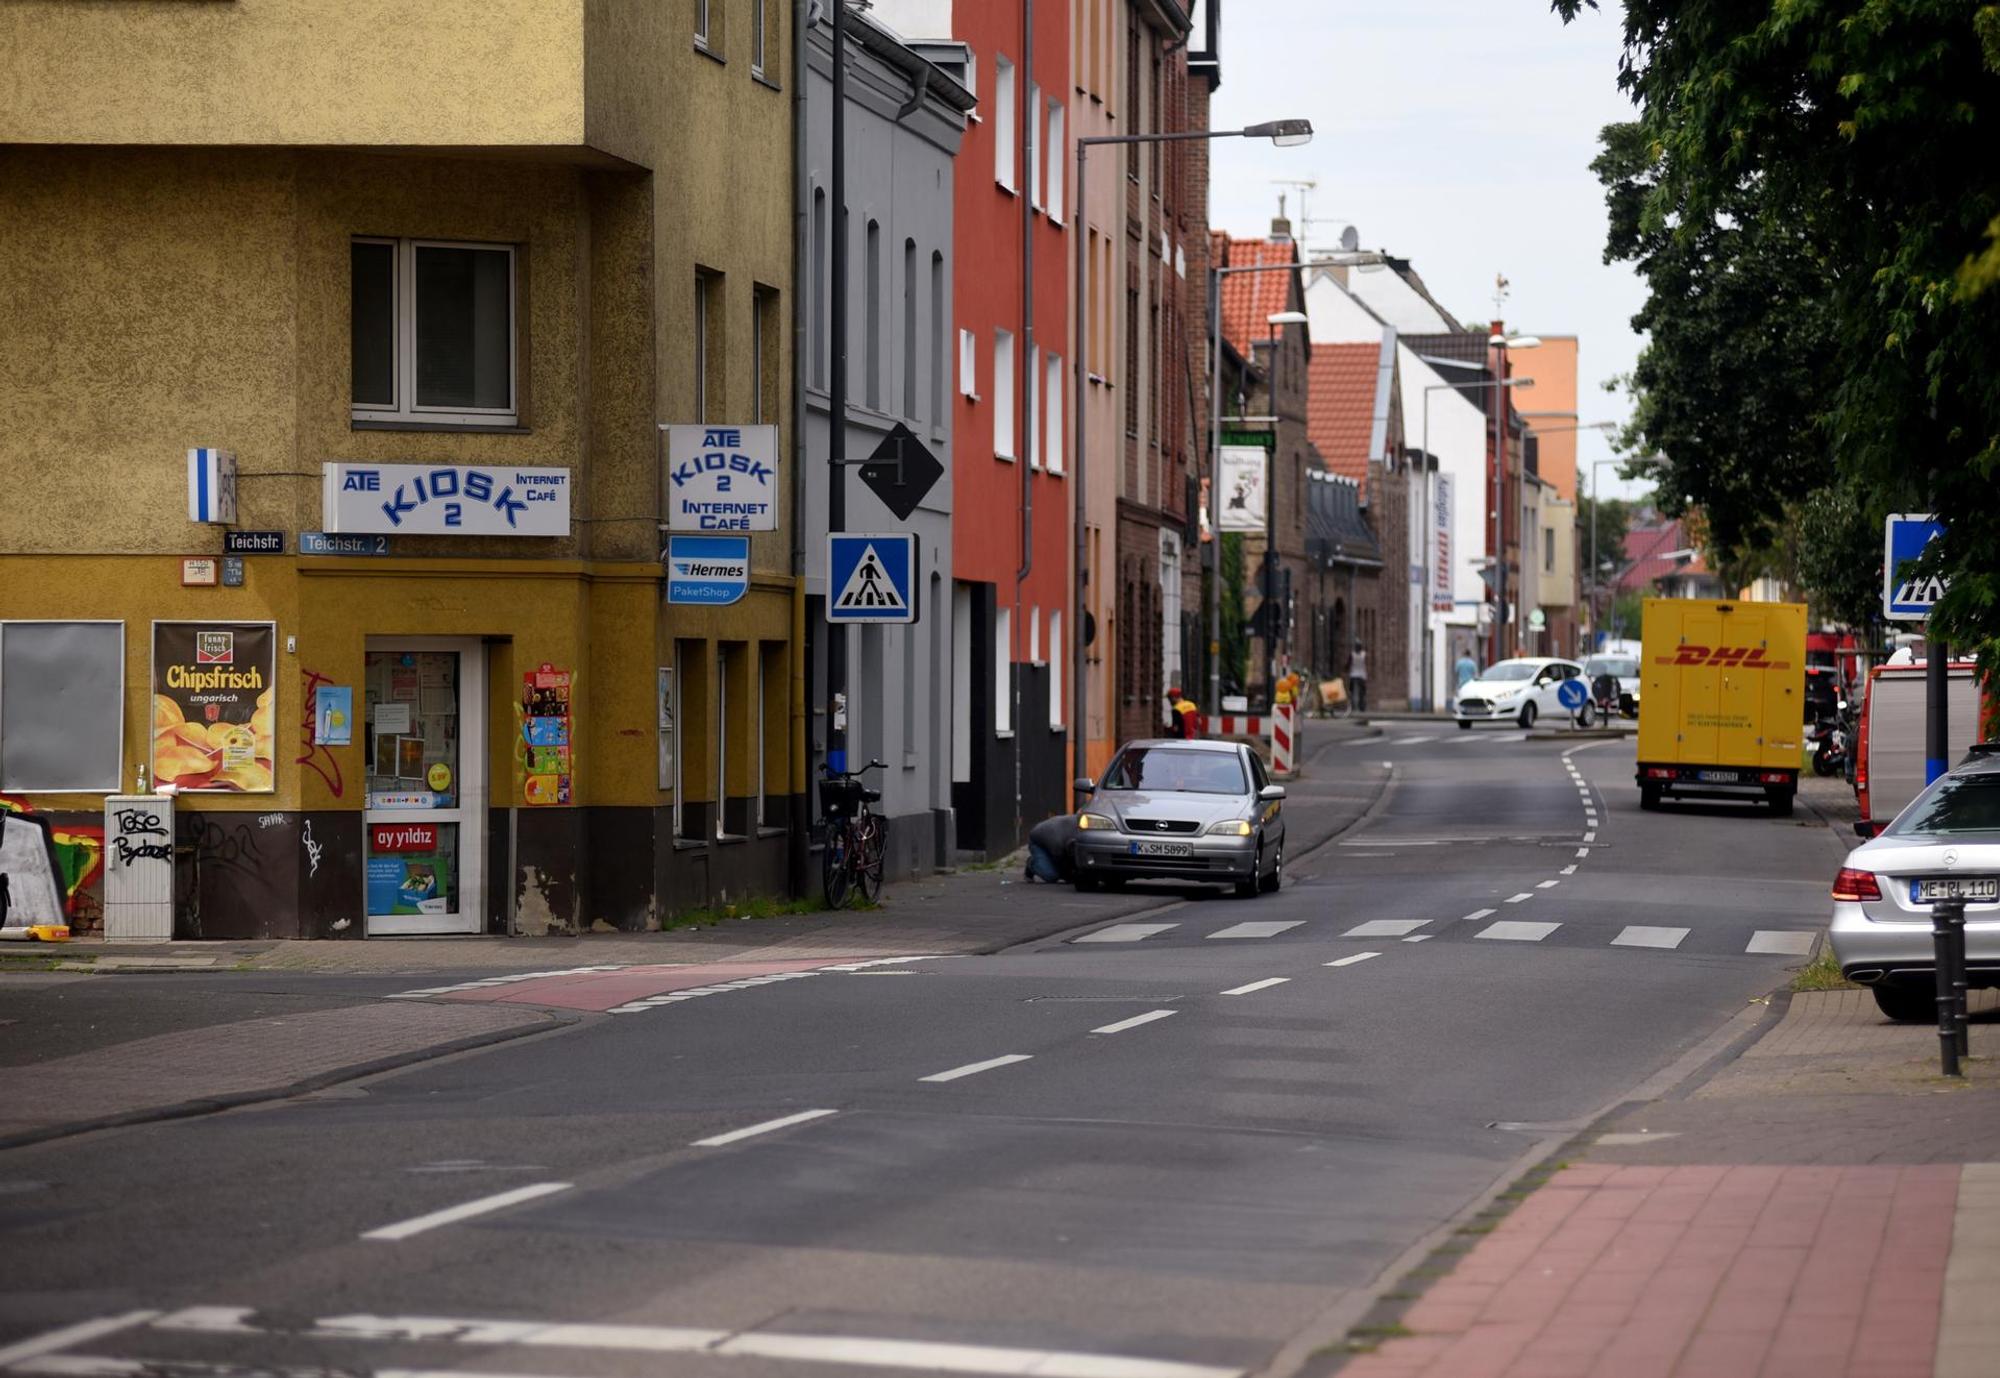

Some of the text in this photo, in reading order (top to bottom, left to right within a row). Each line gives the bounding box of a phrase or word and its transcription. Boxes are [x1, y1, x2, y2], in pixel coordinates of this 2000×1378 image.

[702, 429, 741, 448] ATE
[670, 452, 775, 488] KIOSK
[342, 470, 381, 492] ATE
[516, 473, 566, 485] INTERNET
[716, 475, 732, 492] 2
[381, 468, 529, 529] KIOSK
[682, 500, 768, 514] INTERNET
[444, 502, 462, 527] 2
[700, 515, 750, 530] CAFÉ
[228, 533, 279, 550] Teichstr.
[306, 535, 386, 553] Teichstr. 2
[690, 563, 744, 578] Hermes
[673, 585, 730, 599] PaketShop
[204, 643, 227, 652] frisch
[1674, 645, 1770, 669] DHL
[166, 664, 263, 693] Chipsfrisch
[190, 694, 239, 704] ungarisch
[378, 832, 394, 848] ay
[1919, 881, 1938, 897] ME
[1969, 881, 1995, 897] 110
